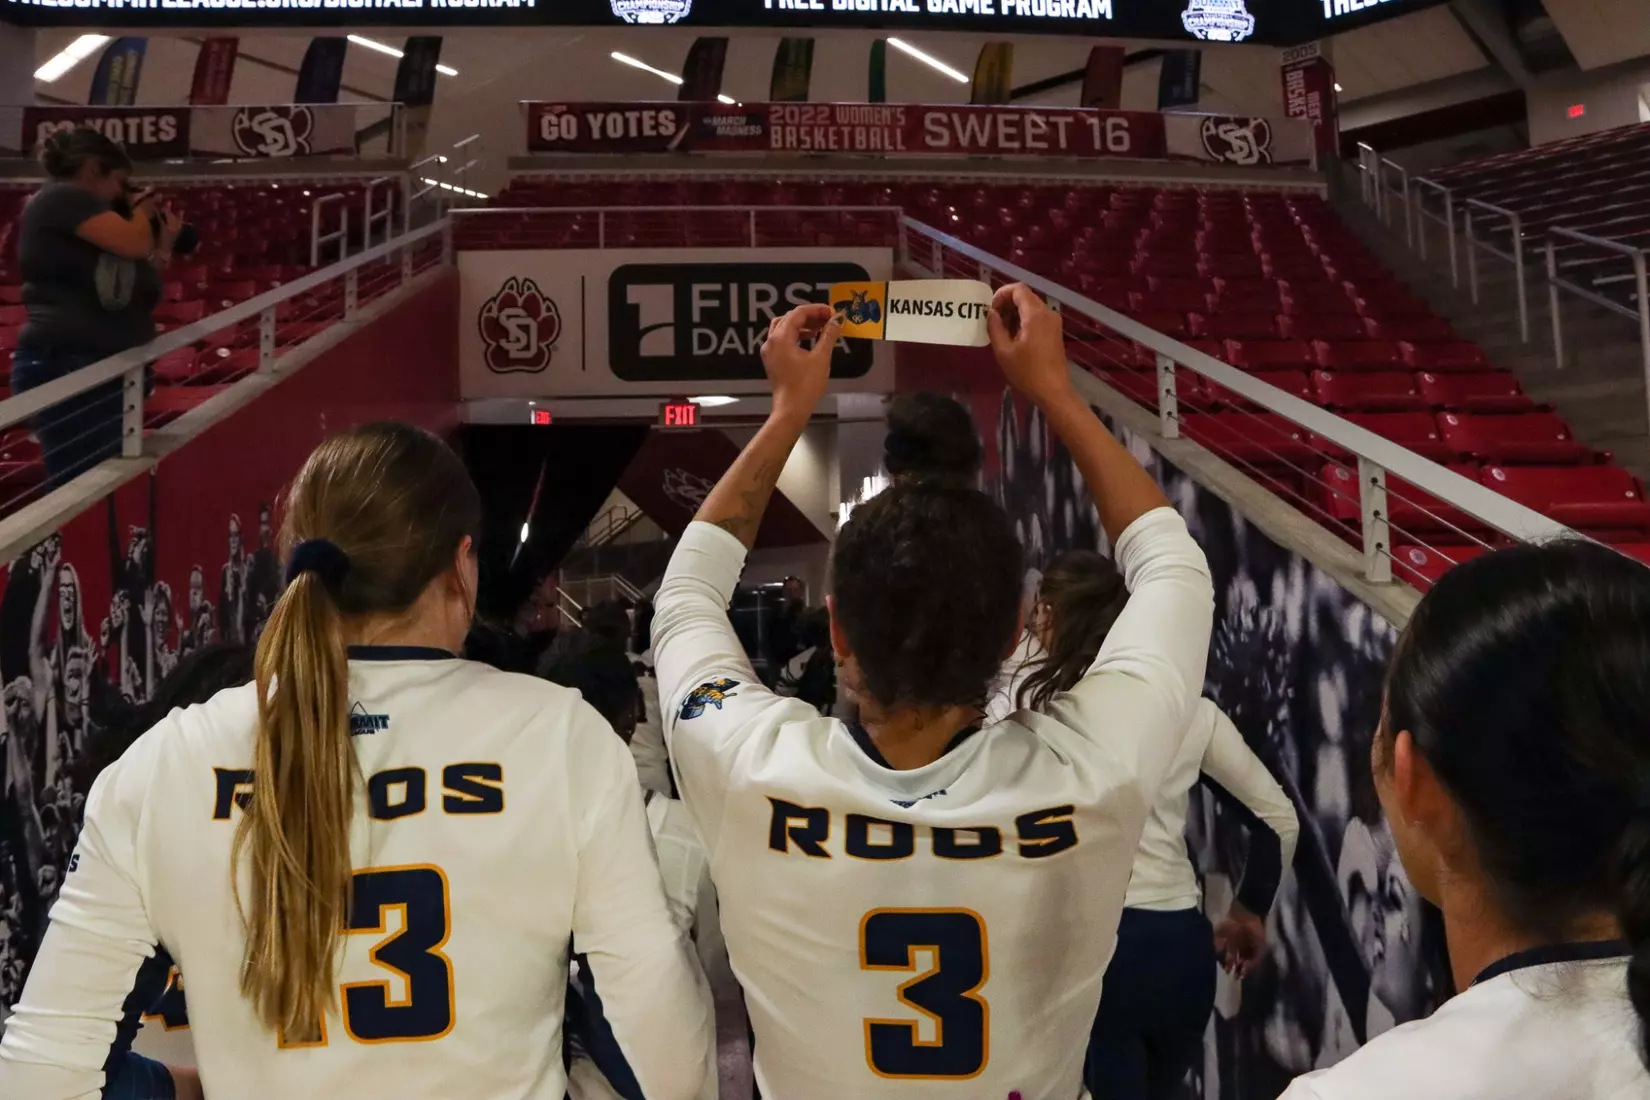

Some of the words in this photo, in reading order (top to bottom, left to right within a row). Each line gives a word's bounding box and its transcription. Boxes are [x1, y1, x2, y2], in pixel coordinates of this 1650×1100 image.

[927, 0, 994, 15] GAME
[1001, 0, 1112, 19] PROGRAM
[1281, 45, 1318, 62] 2005
[1285, 69, 1307, 119] BASKE
[541, 114, 578, 141] GO
[586, 110, 676, 140] YOTES
[711, 115, 748, 126] MARCH
[769, 105, 830, 125] 2022
[836, 105, 906, 126] WOMEN'S
[715, 125, 763, 136] MADNESS
[770, 126, 906, 150] BASKETBALL
[923, 111, 1074, 149] SWEET
[1086, 116, 1131, 152] 16
[890, 298, 954, 318] KANSAS
[691, 326, 851, 358] DAKA
[665, 404, 696, 426] EXIT
[212, 762, 505, 821] ROS
[765, 795, 1080, 861] ROOS
[858, 906, 990, 1081] 3
